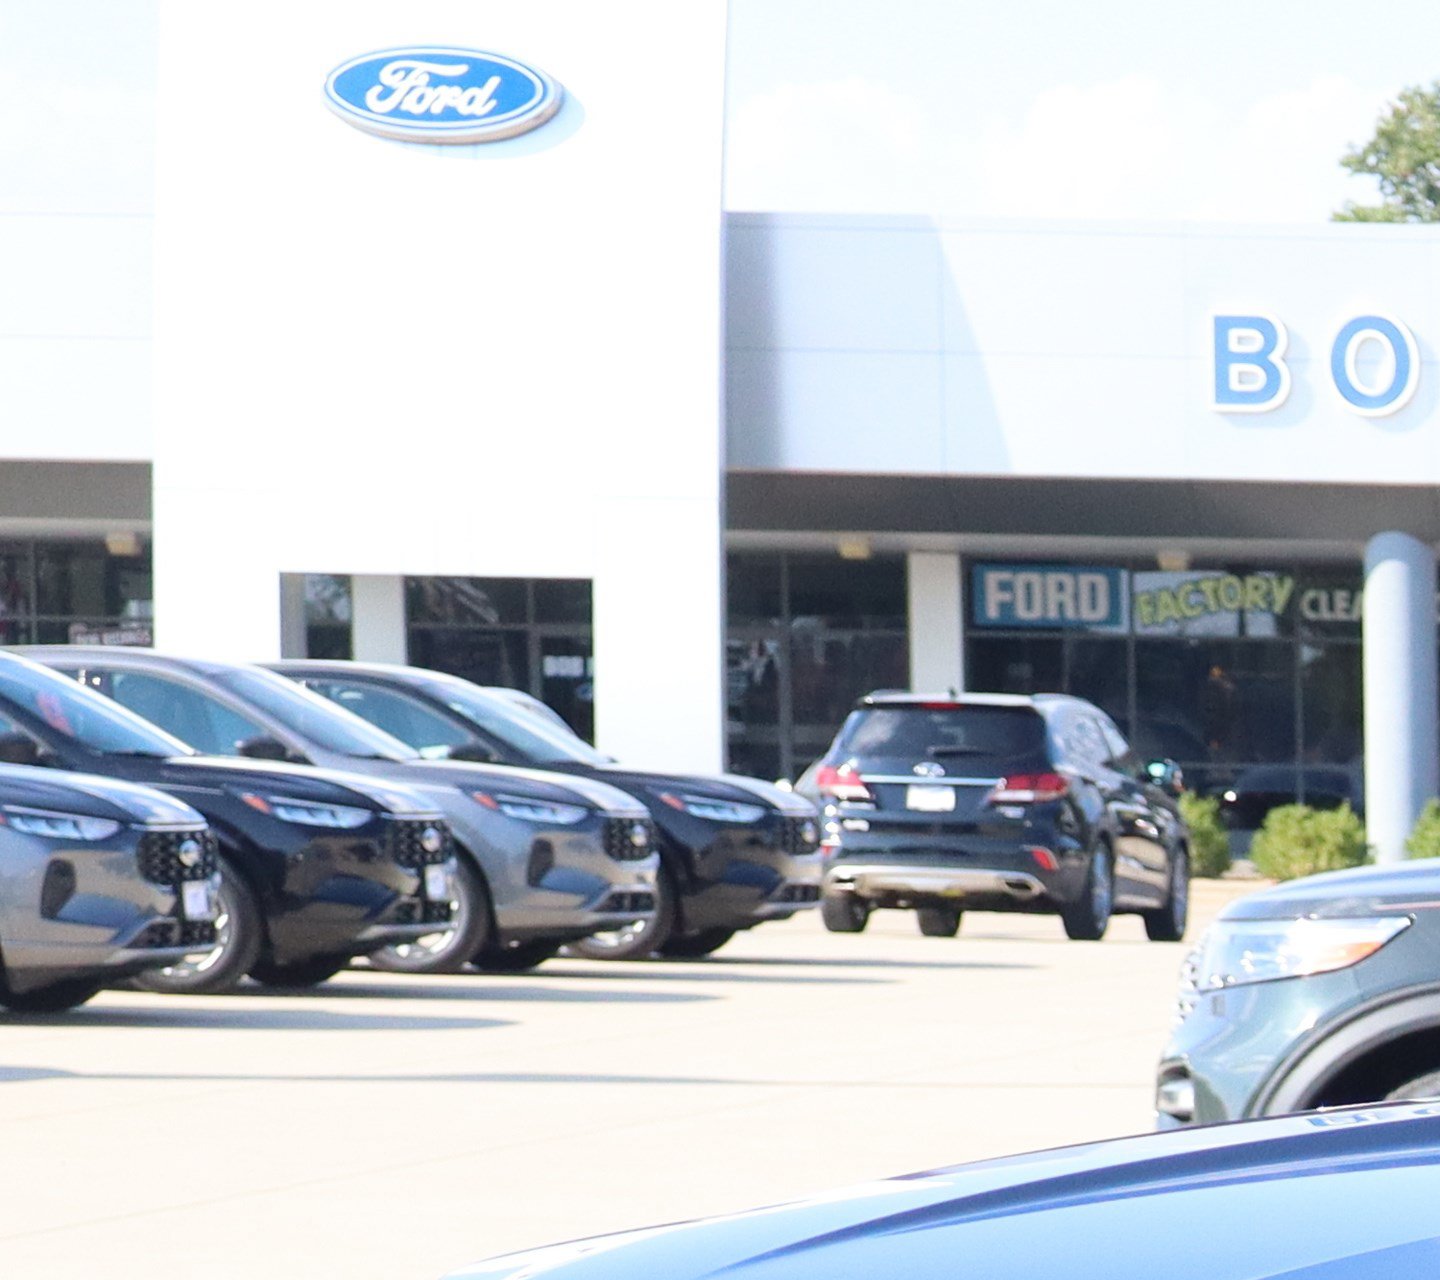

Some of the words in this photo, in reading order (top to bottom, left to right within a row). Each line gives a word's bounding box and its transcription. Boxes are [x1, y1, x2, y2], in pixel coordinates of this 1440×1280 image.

[365, 58, 501, 117] Ford
[983, 570, 1111, 622] FORD
[1133, 575, 1293, 626] FACTORY
